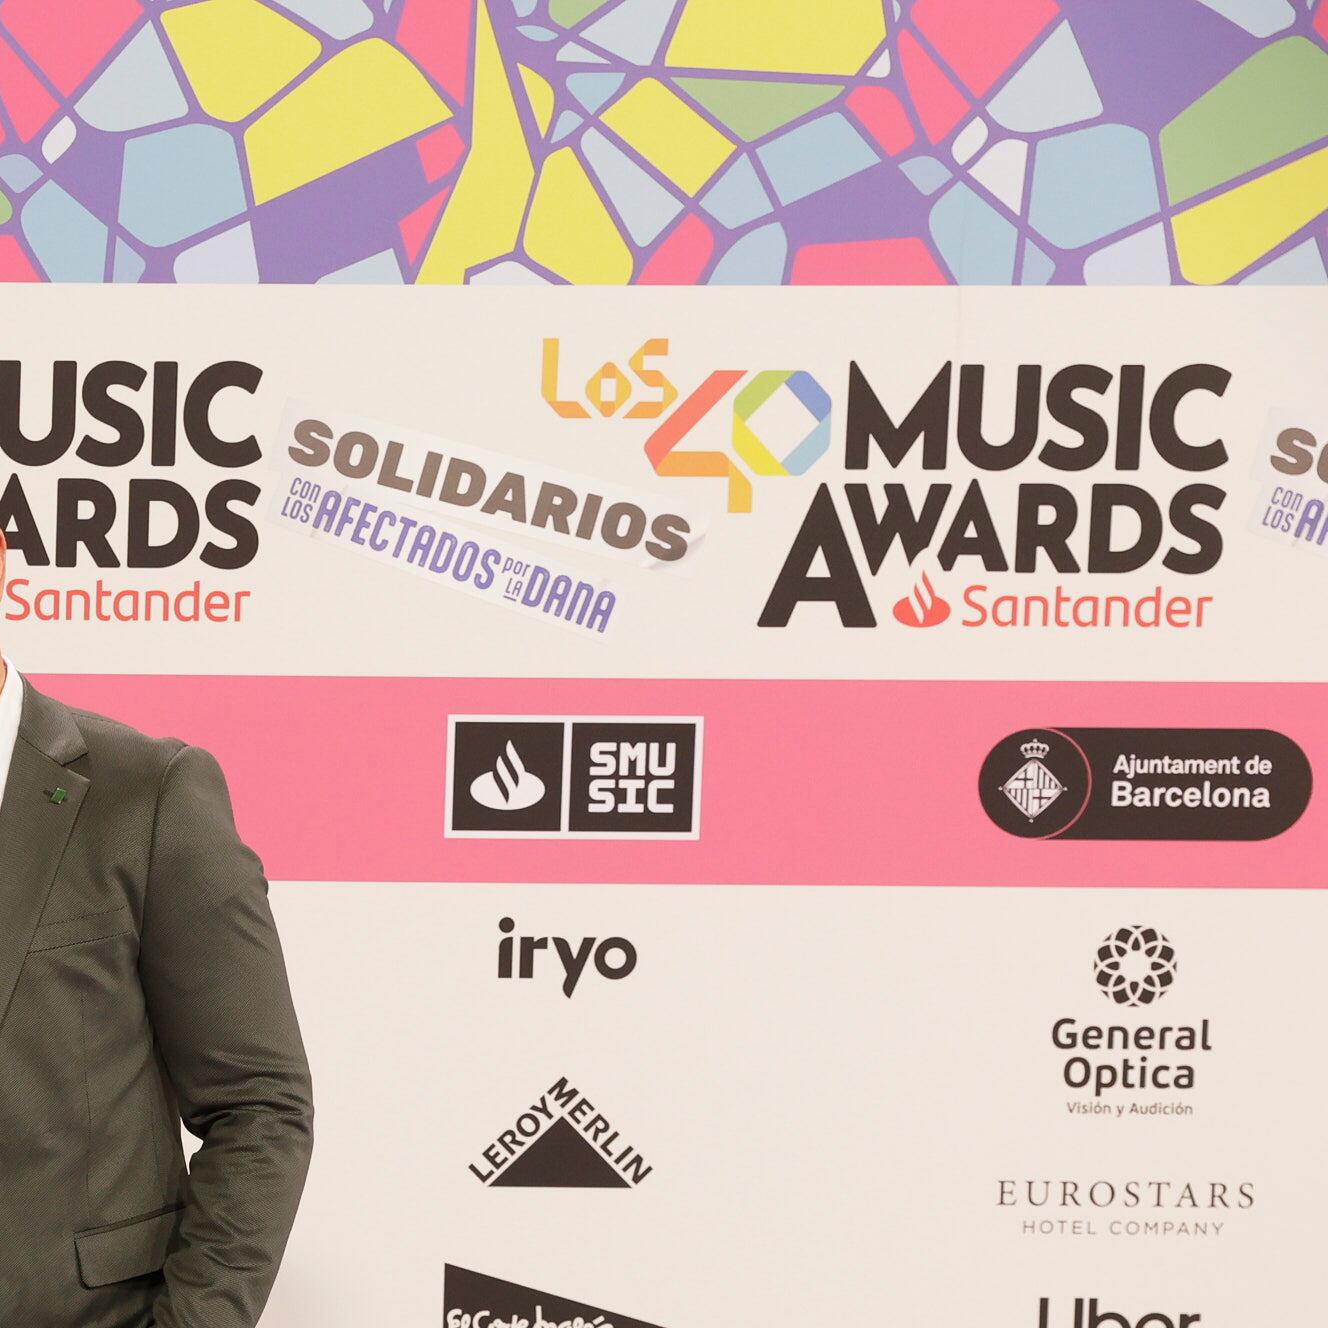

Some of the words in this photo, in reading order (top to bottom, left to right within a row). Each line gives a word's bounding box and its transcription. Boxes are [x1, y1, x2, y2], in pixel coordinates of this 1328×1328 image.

[643, 370, 832, 513] 40
[844, 360, 1232, 471] MUSIC
[288, 419, 690, 561] SOLIDARIOS
[290, 477, 319, 503] CON
[281, 497, 313, 524] LOS
[1262, 506, 1294, 532] LOS
[313, 490, 501, 590] AFECTADOS
[757, 478, 1226, 628] AWARDS
[5, 579, 250, 621] Santander
[506, 578, 523, 596] LA
[521, 565, 616, 633] DANA
[962, 585, 1213, 629] Santander
[589, 742, 676, 776] SMU
[1113, 753, 1240, 778] Ajuntament
[1243, 755, 1272, 775] de
[588, 779, 675, 813] SIC
[1111, 781, 1271, 809] Barcelona
[497, 916, 637, 999] iryo
[1052, 1018, 1212, 1051] General
[1063, 1056, 1195, 1097] Optica
[1066, 1101, 1112, 1115] Visión
[1116, 1104, 1125, 1118] y
[1129, 1102, 1193, 1116] Audición
[467, 1094, 554, 1184] LEROY
[546, 1075, 654, 1185] MERLIN
[996, 1179, 1255, 1209] EUROSTARS
[1022, 1220, 1097, 1235] HOTEL
[1109, 1221, 1225, 1236] COMPANY
